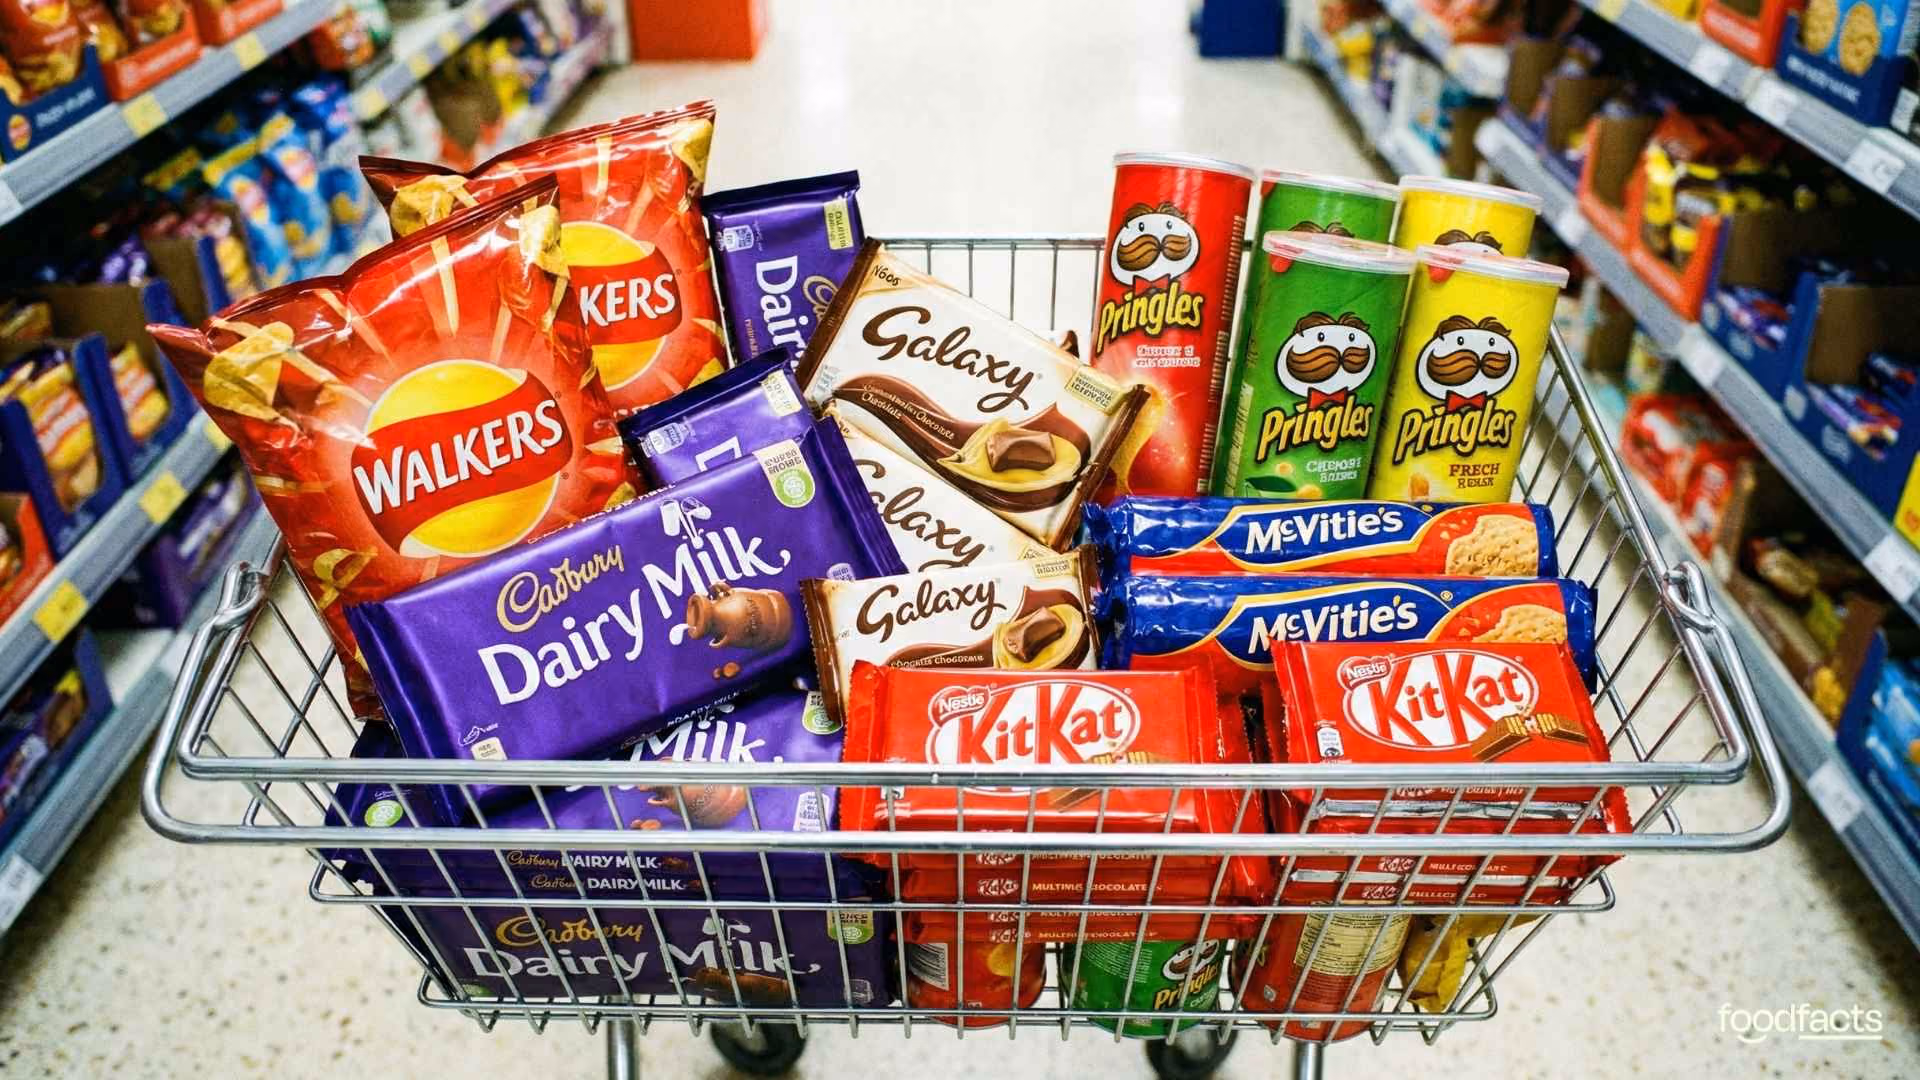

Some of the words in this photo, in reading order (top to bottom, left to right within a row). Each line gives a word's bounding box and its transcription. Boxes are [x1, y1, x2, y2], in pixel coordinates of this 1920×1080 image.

[579, 272, 676, 327] KERS
[756, 254, 809, 366] Dair
[1096, 280, 1205, 356] Pringles
[862, 305, 1035, 412] Galaxy
[352, 399, 564, 516] WALKERS
[1256, 393, 1374, 464] Pringles
[1393, 402, 1516, 464] Pringles
[1245, 506, 1404, 555] McVitie's
[477, 589, 645, 706] Dairy
[642, 525, 791, 620] Milk
[495, 543, 625, 634] Cadbury
[856, 579, 1007, 643] Galaxy
[1248, 595, 1418, 655] McVitie's
[957, 683, 1122, 764] KitKat
[1366, 653, 1524, 746] KitKat
[587, 878, 640, 890] DAIRY
[616, 856, 659, 869] MLK
[464, 947, 649, 981] Dairy
